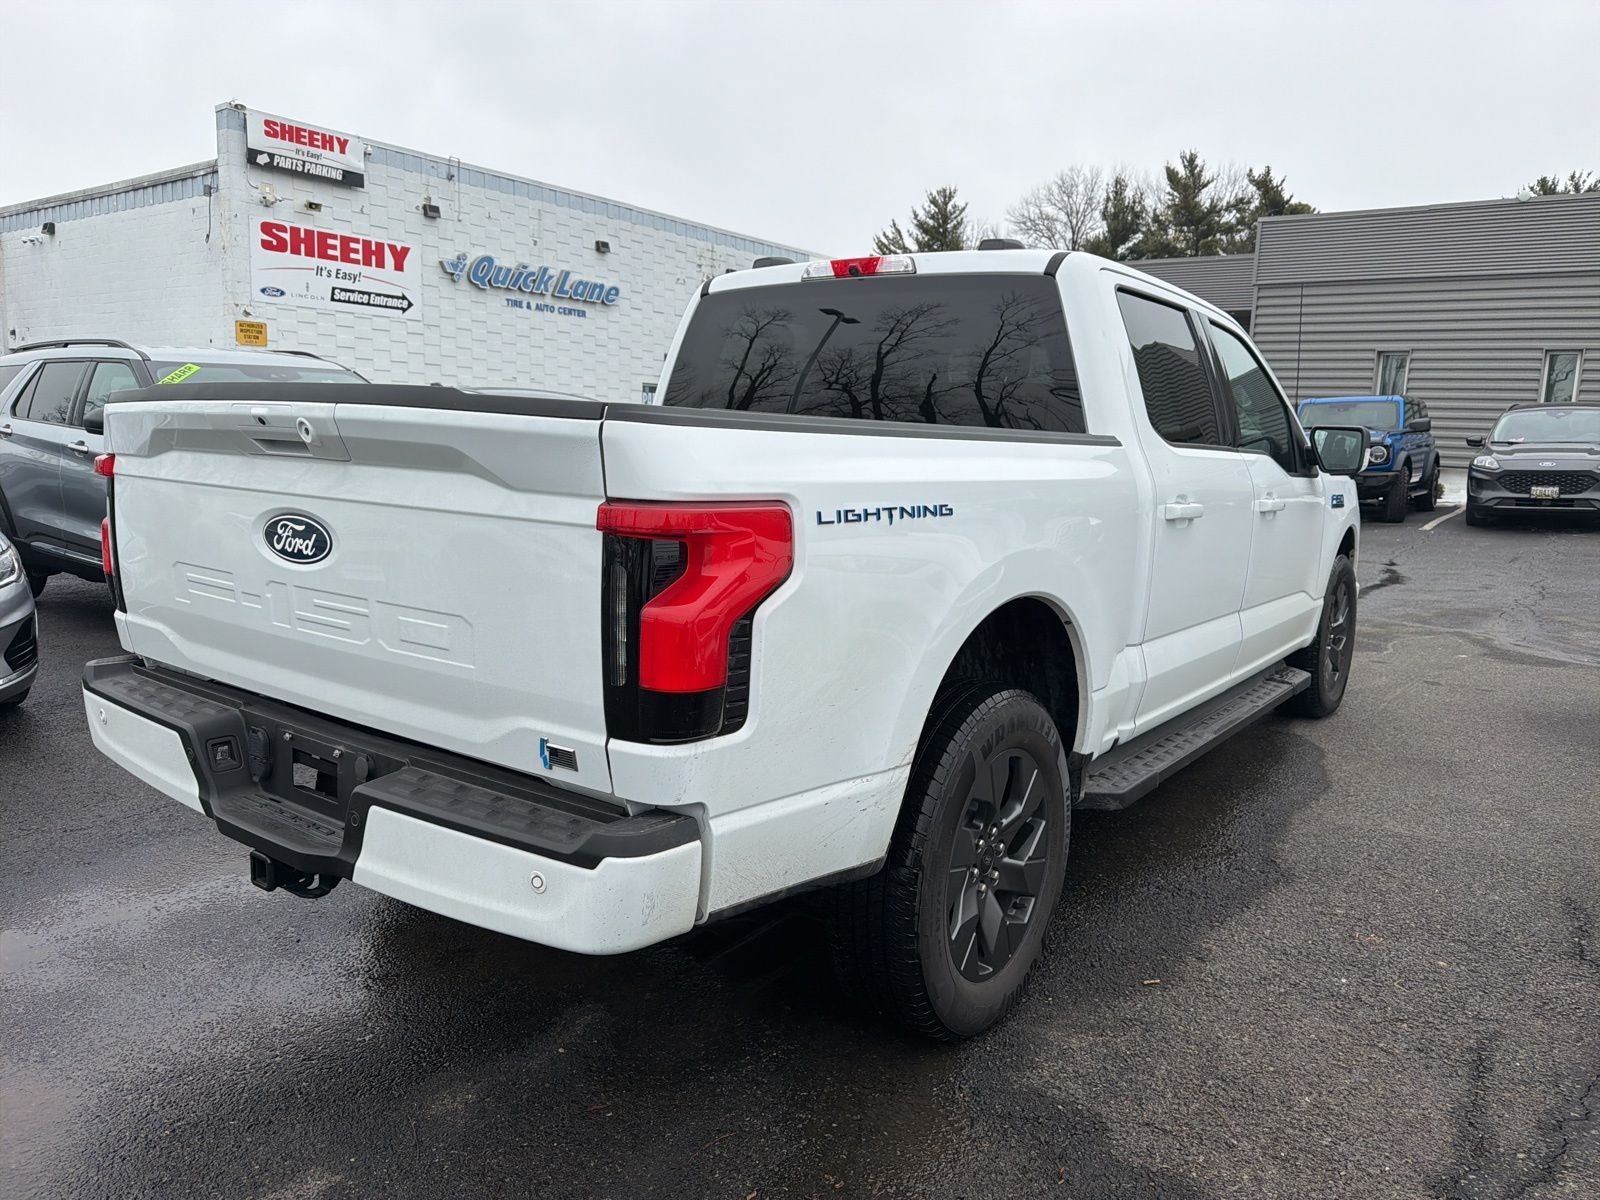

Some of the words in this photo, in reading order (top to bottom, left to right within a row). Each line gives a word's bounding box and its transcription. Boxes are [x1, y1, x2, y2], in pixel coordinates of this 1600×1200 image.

[263, 118, 350, 155] SHEEHY
[273, 154, 303, 172] PARTS
[304, 161, 344, 180] PARKING
[295, 148, 305, 156] It's
[306, 151, 323, 161] Easy!
[260, 221, 411, 273] SHEEHY
[315, 265, 332, 278] It's
[335, 268, 362, 284] Easy!
[468, 254, 555, 297] Quick
[553, 269, 620, 305] Lane
[333, 288, 369, 304] Service
[369, 293, 409, 308] Entrance
[505, 298, 524, 309] TIRE
[526, 301, 532, 310] &
[535, 303, 556, 313] AUTO
[557, 306, 587, 318] CENTER
[815, 503, 954, 526] LIGHTNING
[273, 520, 317, 556] Ford
[173, 560, 476, 669] F-150
